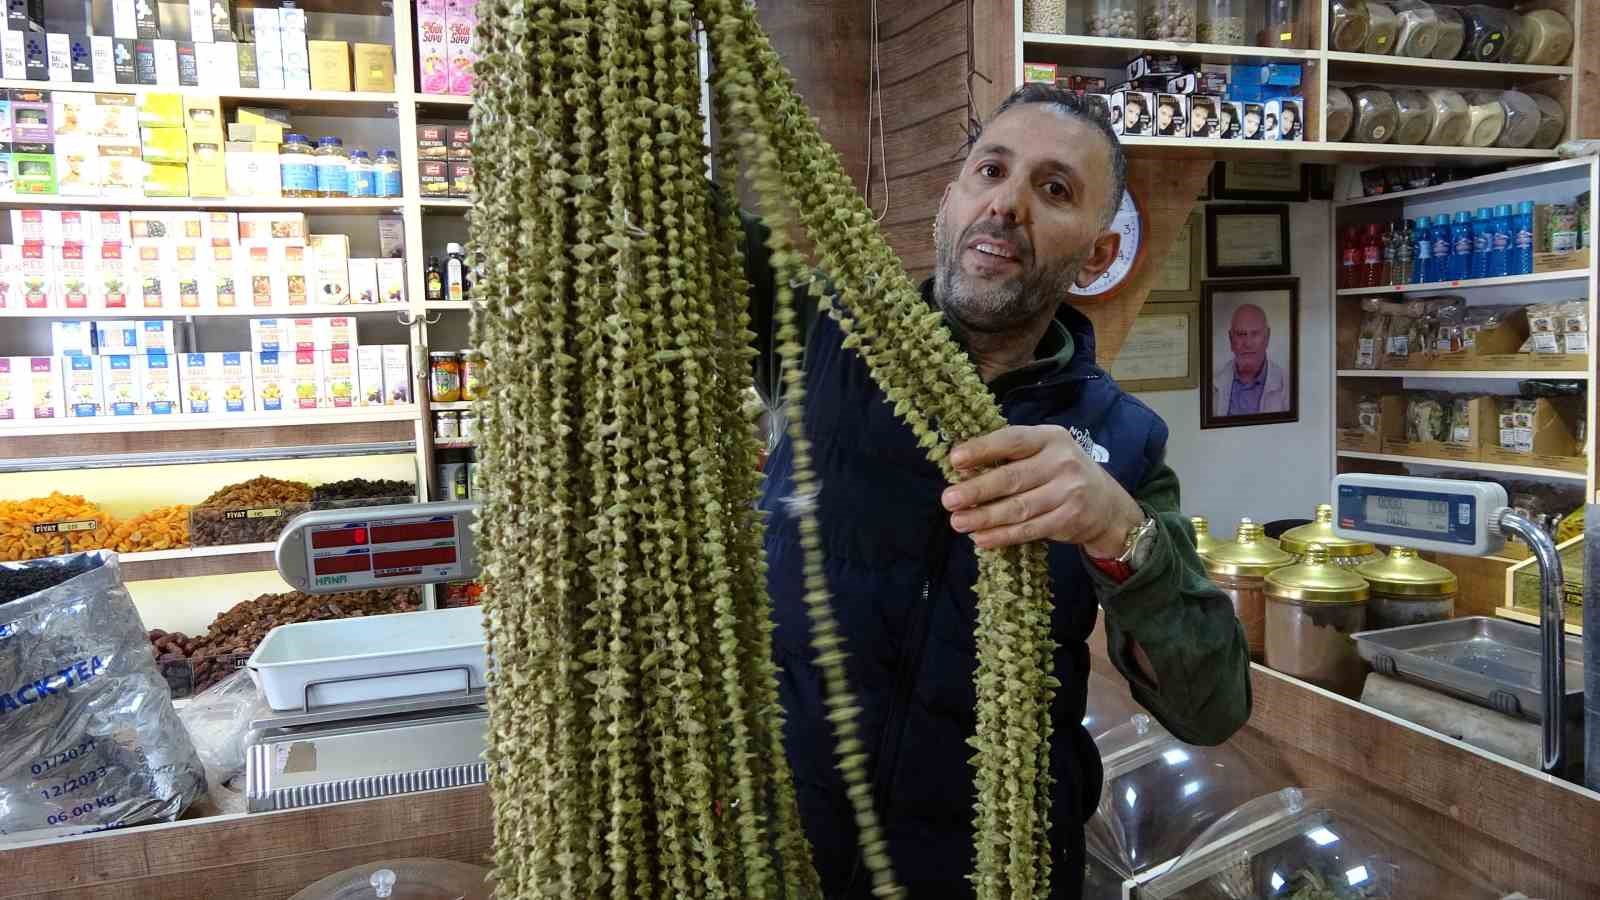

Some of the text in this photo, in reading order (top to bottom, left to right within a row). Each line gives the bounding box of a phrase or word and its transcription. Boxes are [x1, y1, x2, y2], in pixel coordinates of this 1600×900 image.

[1123, 224, 1131, 235] 3
[56, 655, 108, 688] TEA
[31, 740, 97, 774] 01/2021
[41, 766, 109, 800] 12/2023
[47, 793, 117, 825] 06.00 kg
